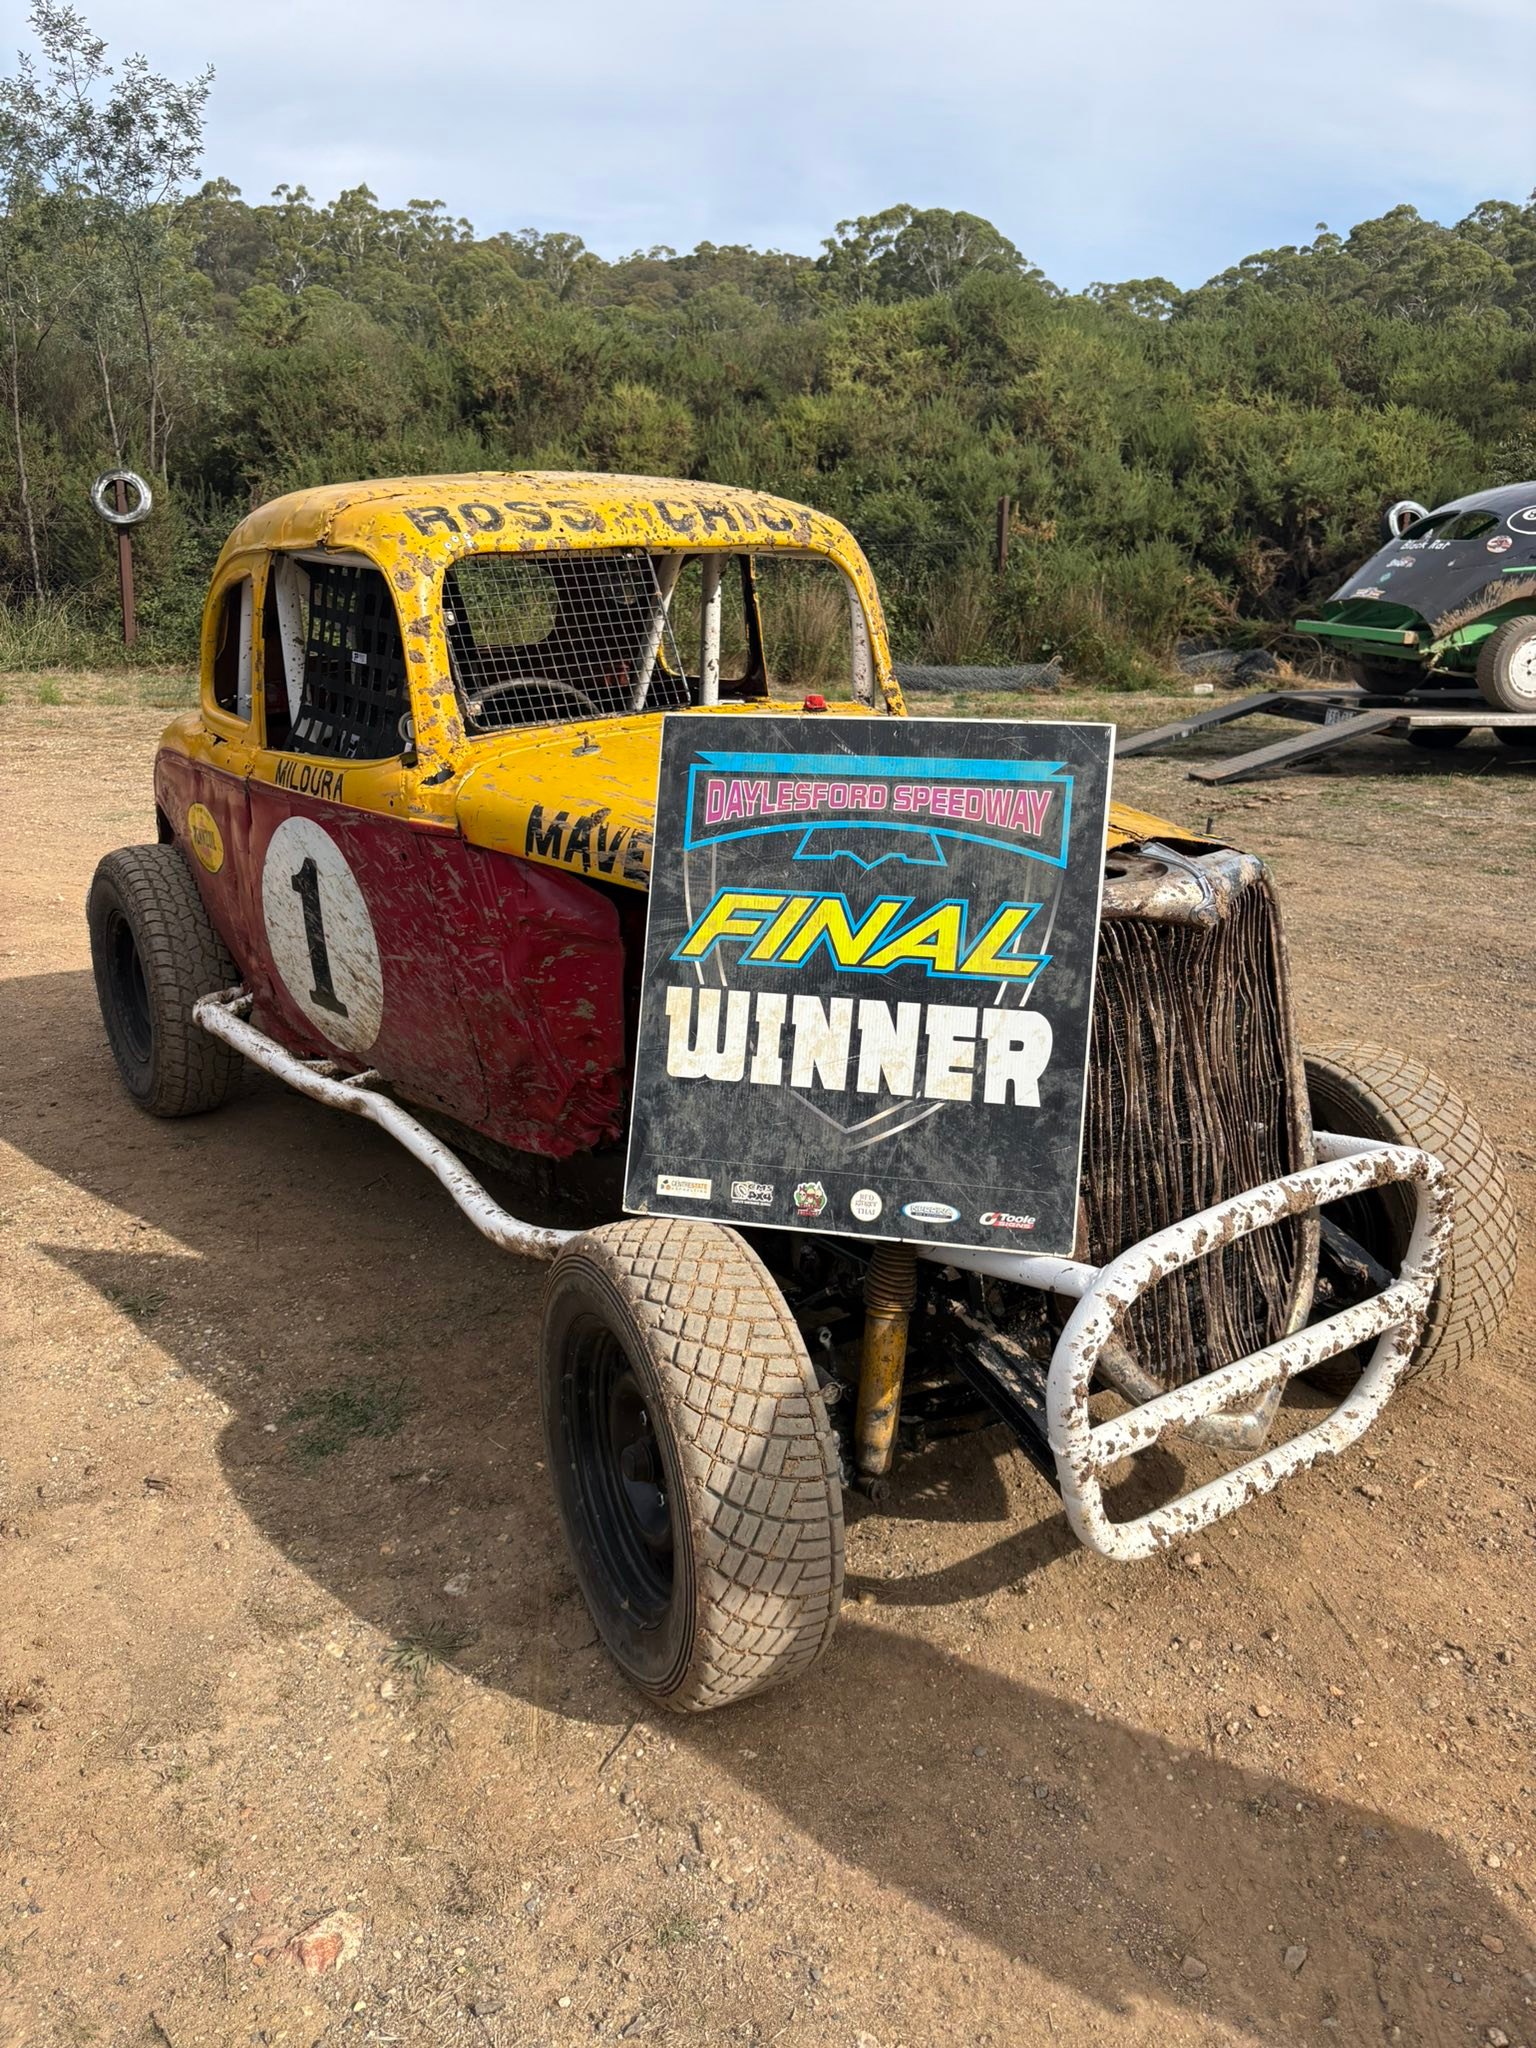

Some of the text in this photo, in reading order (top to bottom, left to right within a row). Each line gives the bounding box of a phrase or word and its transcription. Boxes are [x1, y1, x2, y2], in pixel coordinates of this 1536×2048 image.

[403, 500, 596, 538] ROSS
[275, 759, 344, 802] MILDURA
[705, 779, 1052, 837] DAYLESFORD SPEEDWAY
[291, 857, 349, 1018] 1
[672, 888, 1052, 981] FINAL
[665, 985, 1053, 1107] WINNER
